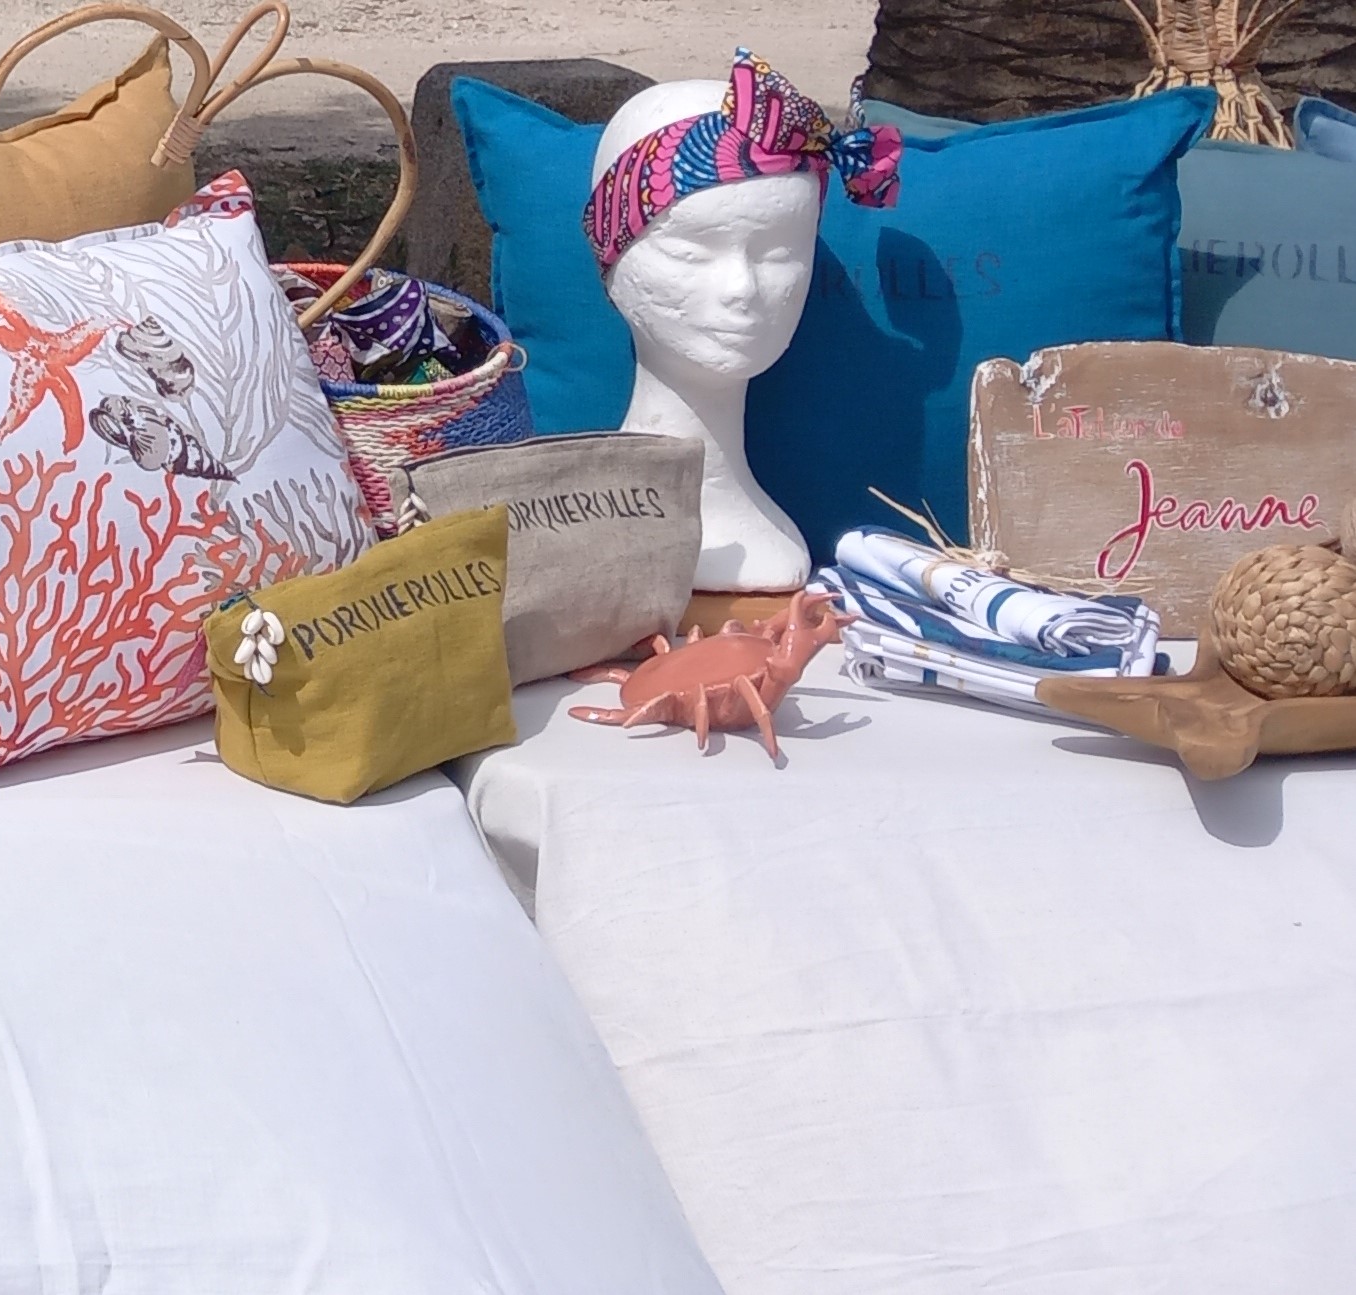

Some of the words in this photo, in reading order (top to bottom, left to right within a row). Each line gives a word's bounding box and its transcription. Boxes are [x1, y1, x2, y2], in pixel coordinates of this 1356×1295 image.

[483, 487, 665, 534] ORQUEROLLES
[1095, 458, 1328, 583] Jeanne
[291, 559, 503, 662] PORQUEROLLES
